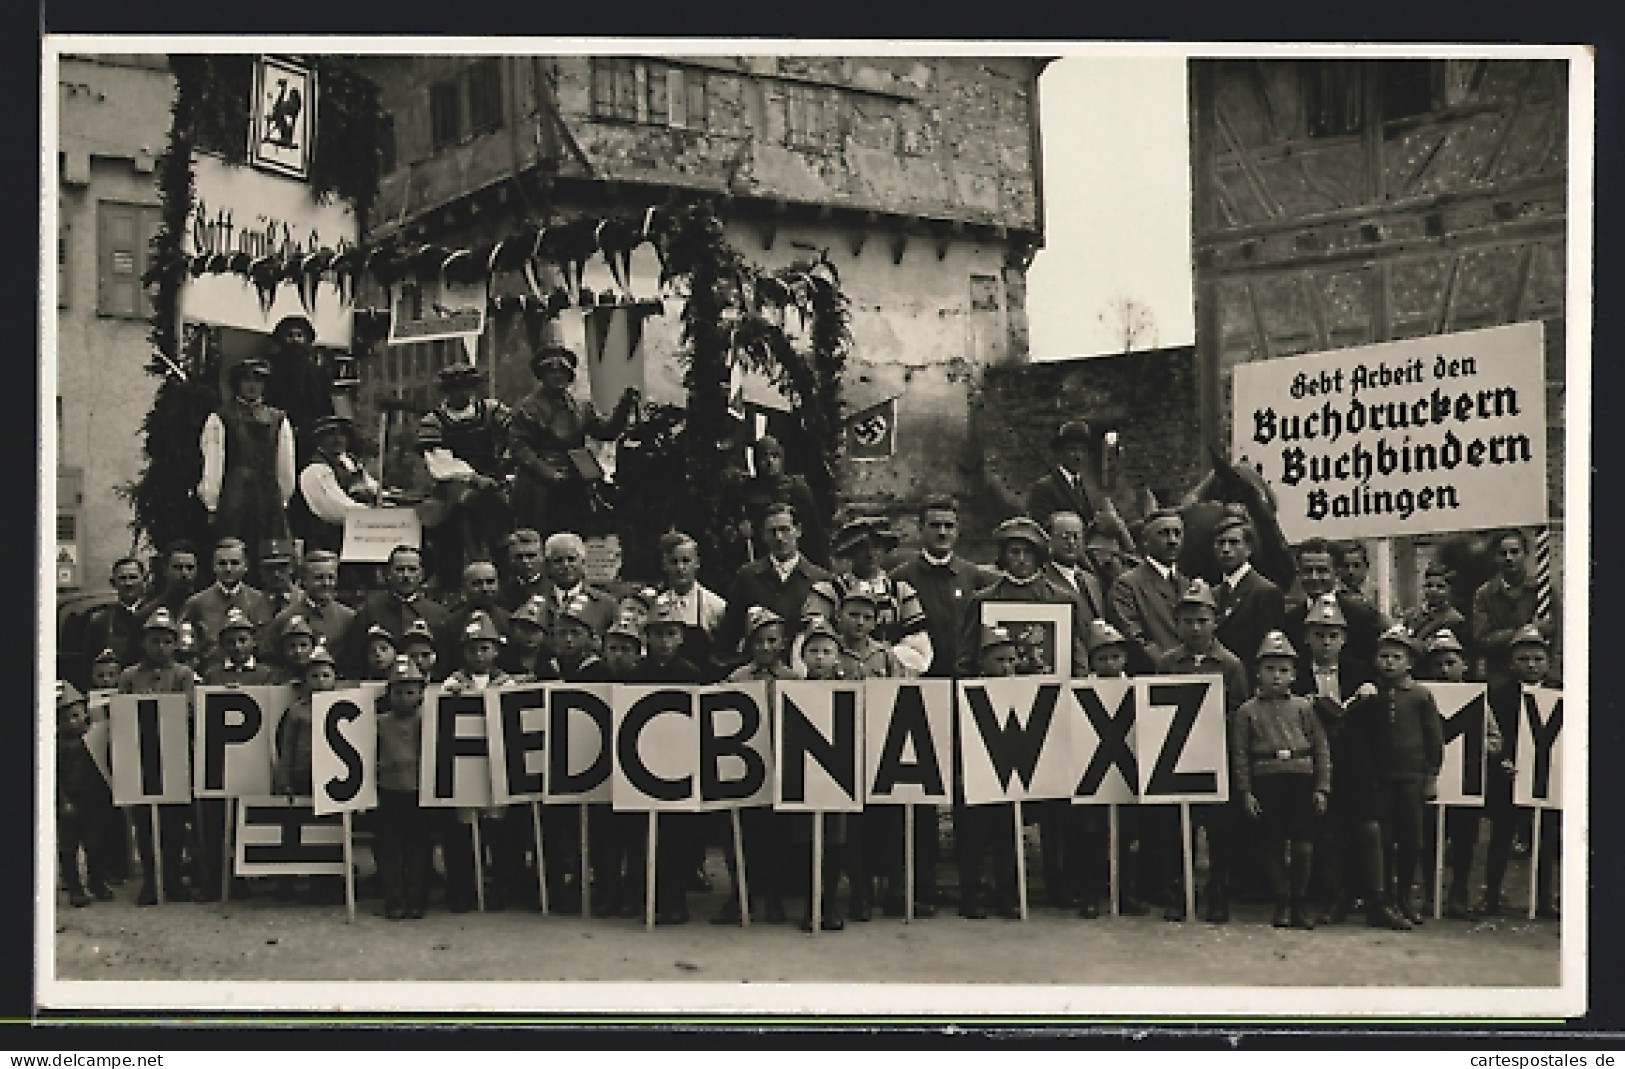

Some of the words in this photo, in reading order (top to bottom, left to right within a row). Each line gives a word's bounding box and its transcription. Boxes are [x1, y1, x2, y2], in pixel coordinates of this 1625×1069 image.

[1253, 385, 1521, 445] Buchdruckern
[1289, 370, 1343, 399] Gebt
[1350, 357, 1425, 397] Arbeit
[1433, 354, 1477, 379] den
[1281, 429, 1532, 486] Buchbindern
[1306, 484, 1460, 520] Balingen
[138, 700, 163, 795] I
[205, 693, 262, 789] P
[324, 700, 363, 802] S
[435, 696, 488, 798] F
[501, 688, 545, 795] E
[548, 690, 613, 795] D
[618, 690, 692, 800] C
[702, 691, 766, 801] B
[782, 691, 856, 803] N
[871, 685, 946, 795] A
[963, 685, 1061, 795] W
[1071, 685, 1139, 795] X
[1143, 682, 1218, 795] Z
[1523, 693, 1563, 798] Y
